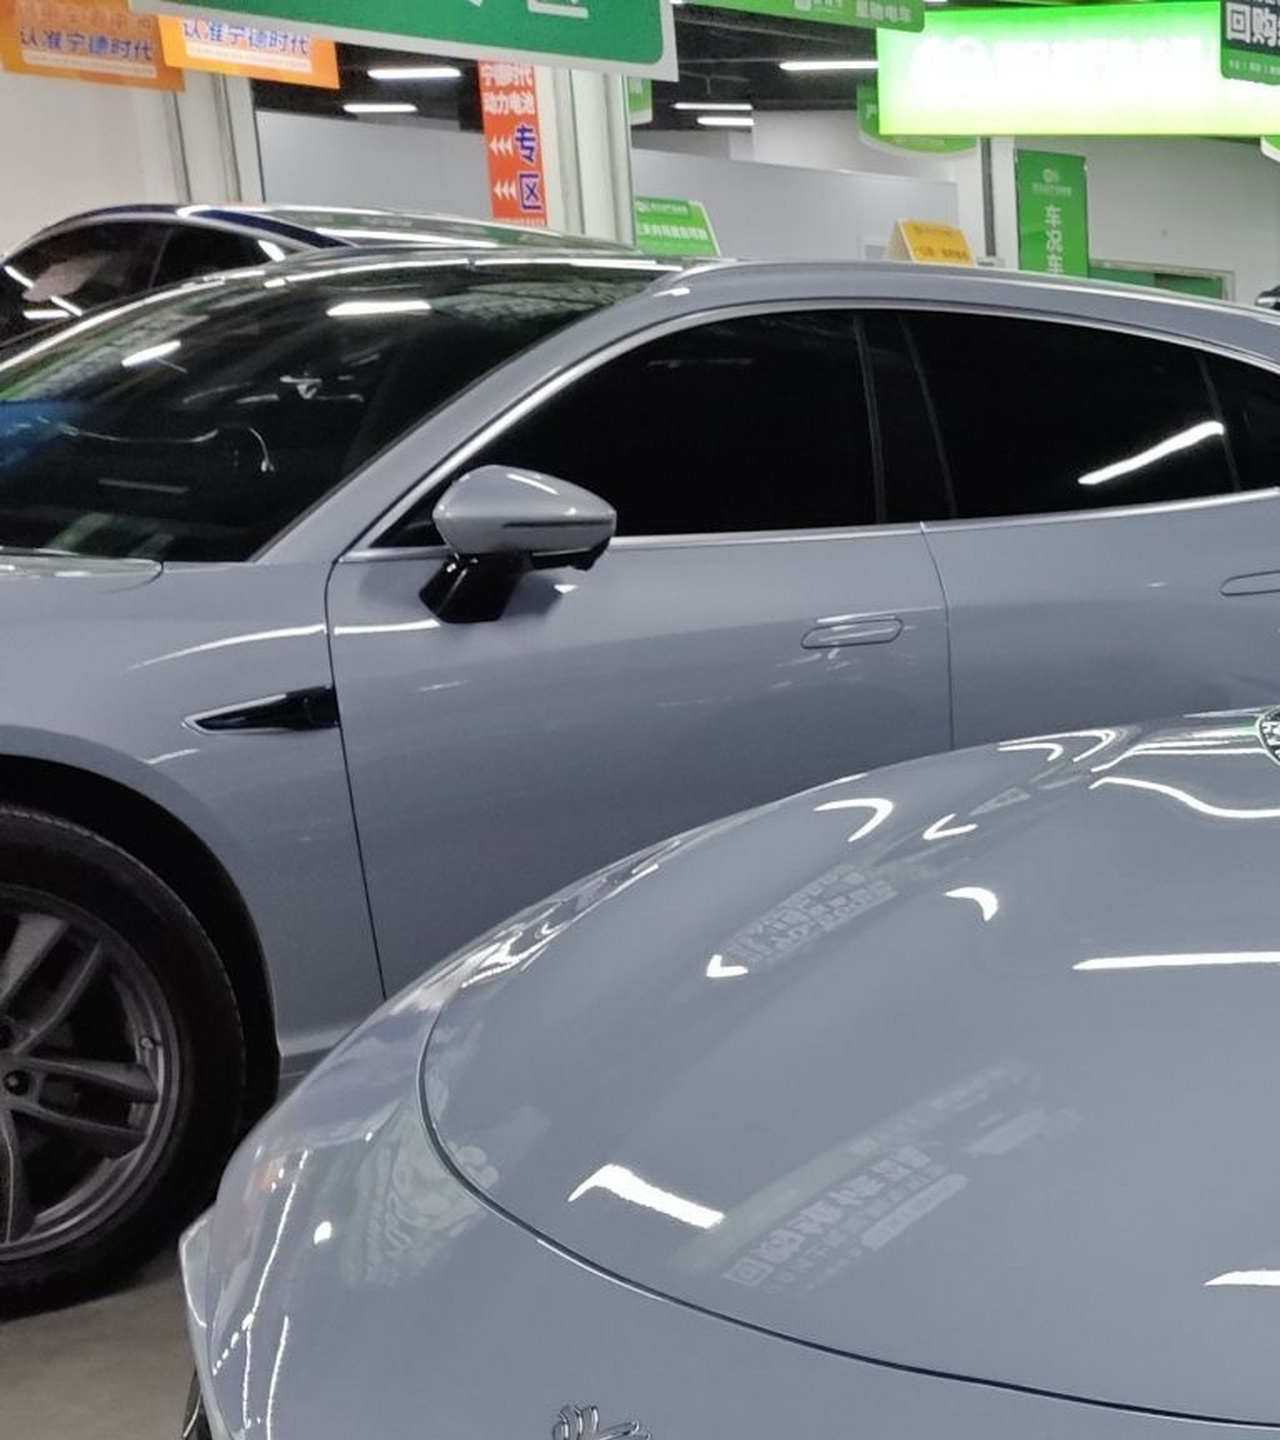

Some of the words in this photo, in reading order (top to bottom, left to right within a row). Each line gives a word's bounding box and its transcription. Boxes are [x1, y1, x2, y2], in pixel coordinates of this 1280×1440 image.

[20, 27, 153, 60] 认准宁德时代
[183, 17, 309, 54] 认准宁德时代
[514, 124, 542, 210] 专区
